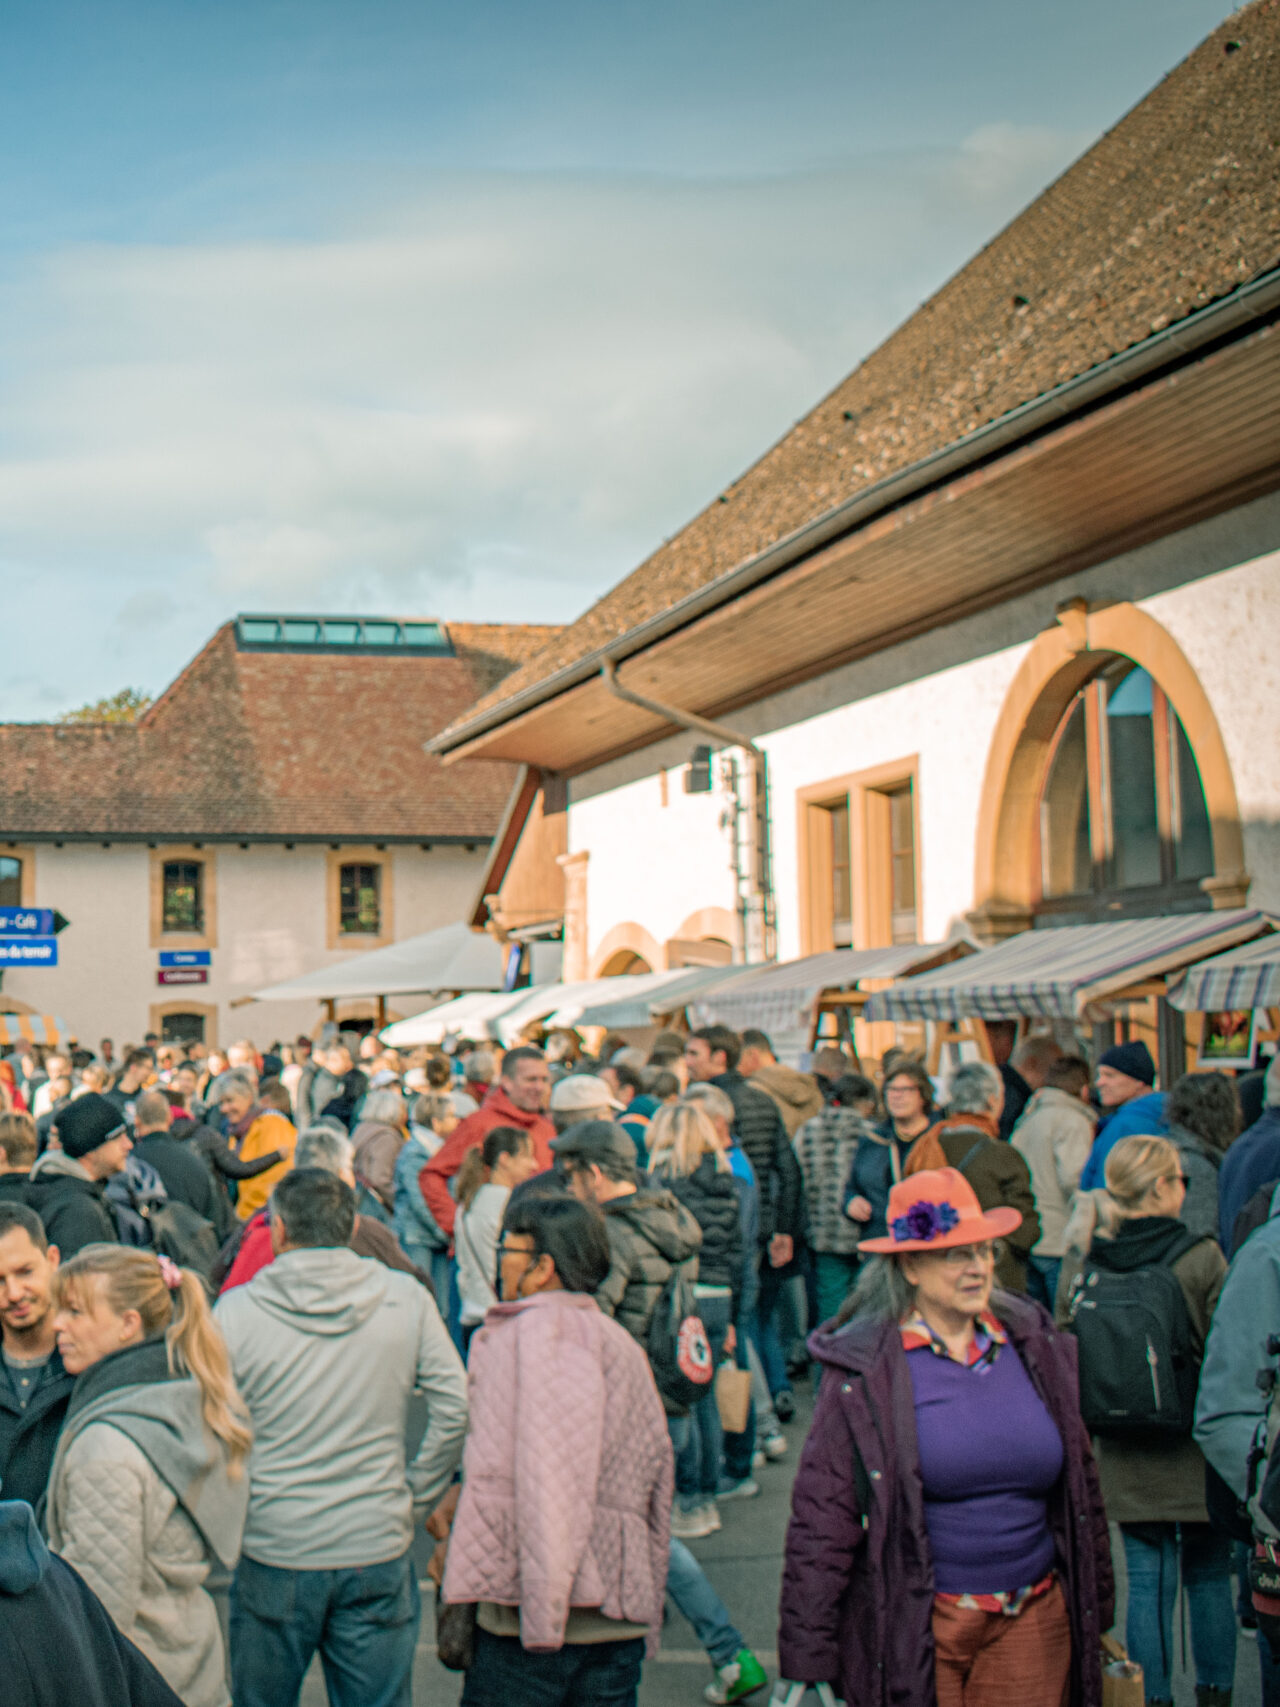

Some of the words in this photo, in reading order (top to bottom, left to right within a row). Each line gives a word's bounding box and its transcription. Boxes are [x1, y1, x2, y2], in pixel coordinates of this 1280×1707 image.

[15, 913, 37, 929] Café
[9, 944, 22, 958] du
[22, 945, 52, 958] terroir
